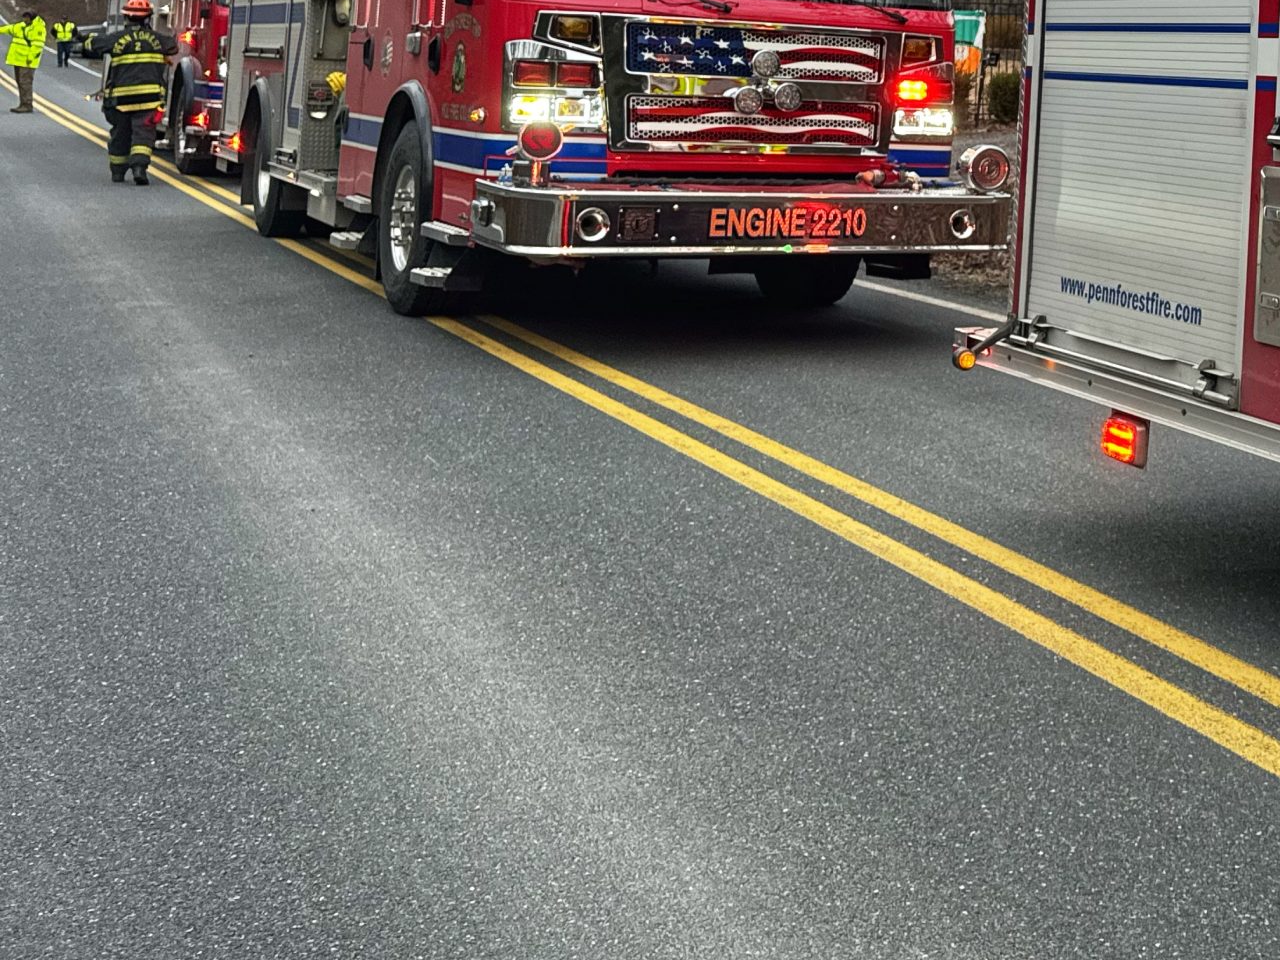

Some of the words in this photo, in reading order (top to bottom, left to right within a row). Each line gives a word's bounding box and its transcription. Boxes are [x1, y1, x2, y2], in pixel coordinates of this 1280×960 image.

[134, 41, 141, 51] 2
[709, 208, 807, 238] ENGINE
[811, 208, 867, 237] 2210
[1060, 276, 1202, 325] www.pennforestfire.com
